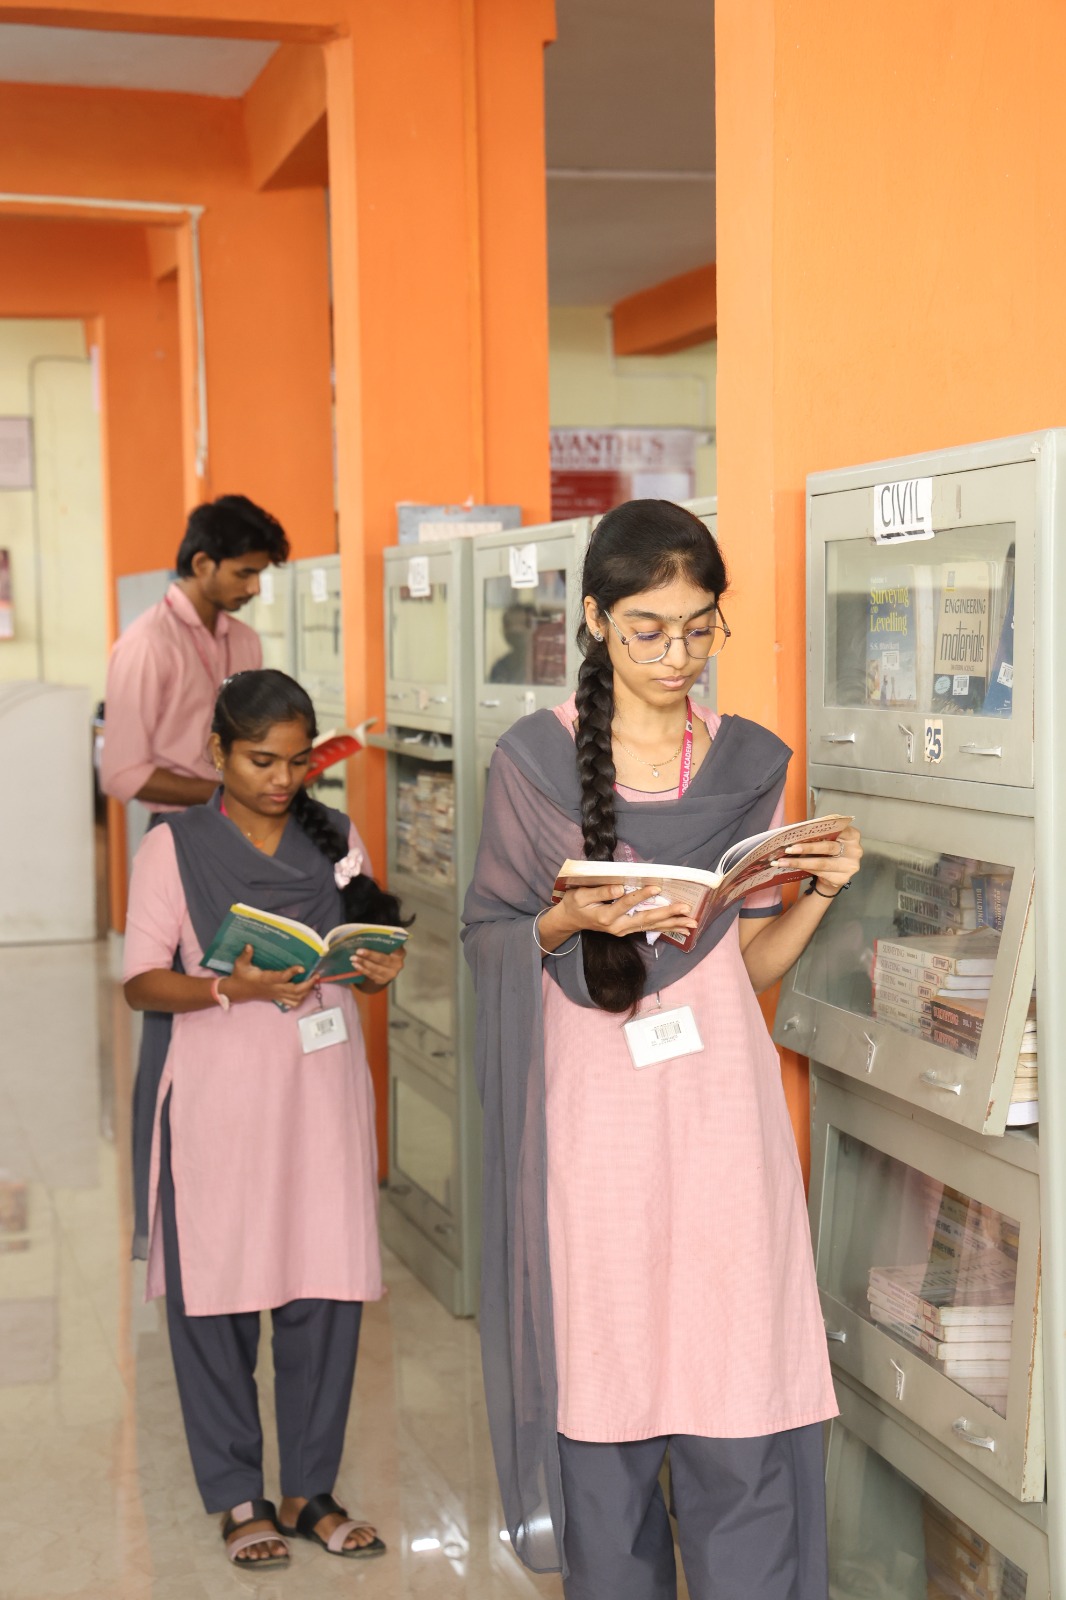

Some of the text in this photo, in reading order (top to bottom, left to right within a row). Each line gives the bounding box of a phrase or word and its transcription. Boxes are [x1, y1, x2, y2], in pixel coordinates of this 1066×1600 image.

[880, 480, 925, 528] CIVIL
[870, 585, 909, 608] Surveying
[944, 598, 986, 615] ENGINEERING
[870, 611, 908, 637] Levelling
[940, 620, 985, 663] materials
[682, 739, 693, 796] OGICAL ACADEMY
[900, 894, 939, 919] SURVEYING
[975, 888, 984, 923] BUILDING
[933, 1005, 959, 1026] SURVEYING
